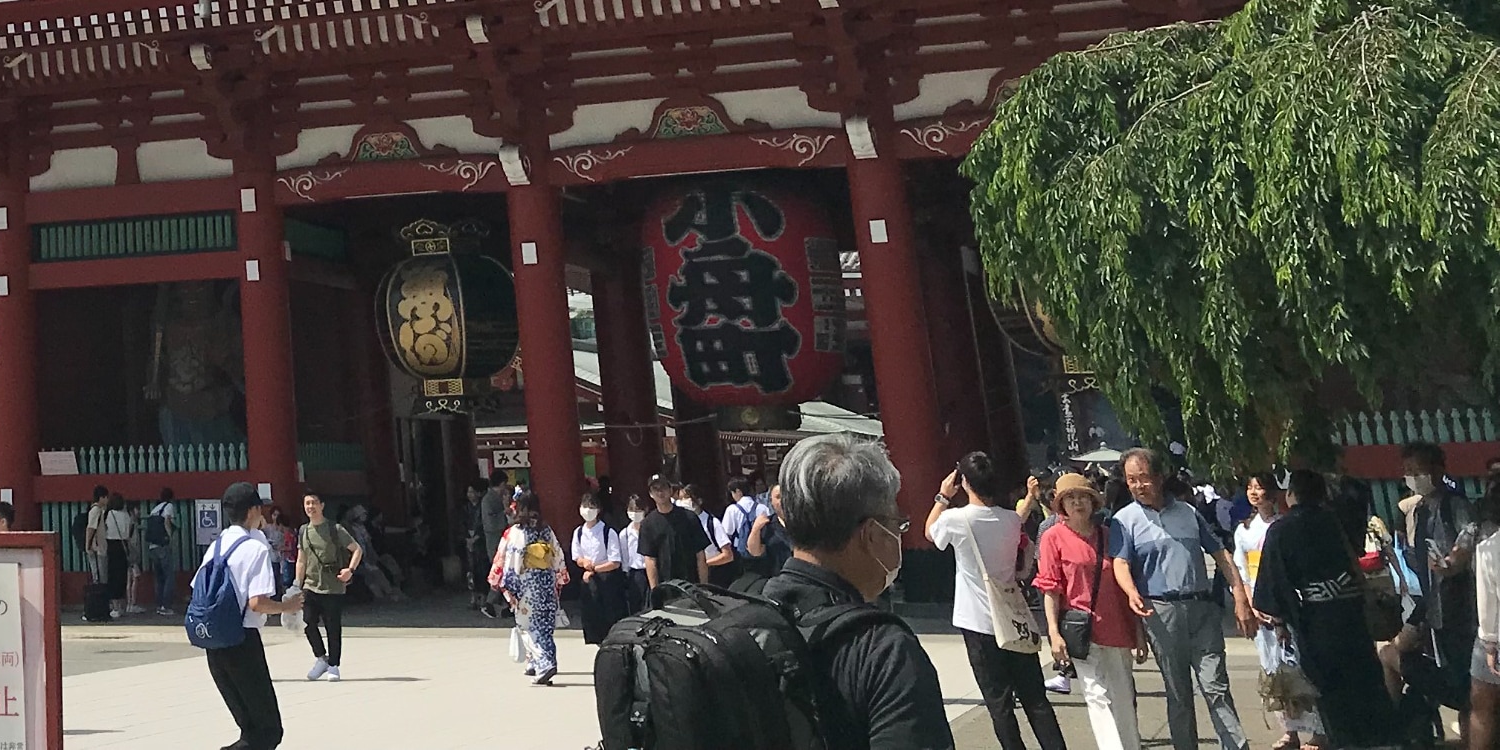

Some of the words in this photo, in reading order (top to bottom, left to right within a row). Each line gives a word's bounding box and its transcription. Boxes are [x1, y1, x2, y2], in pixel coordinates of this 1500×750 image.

[661, 190, 802, 393] 小舟町
[498, 452, 528, 466] みく
